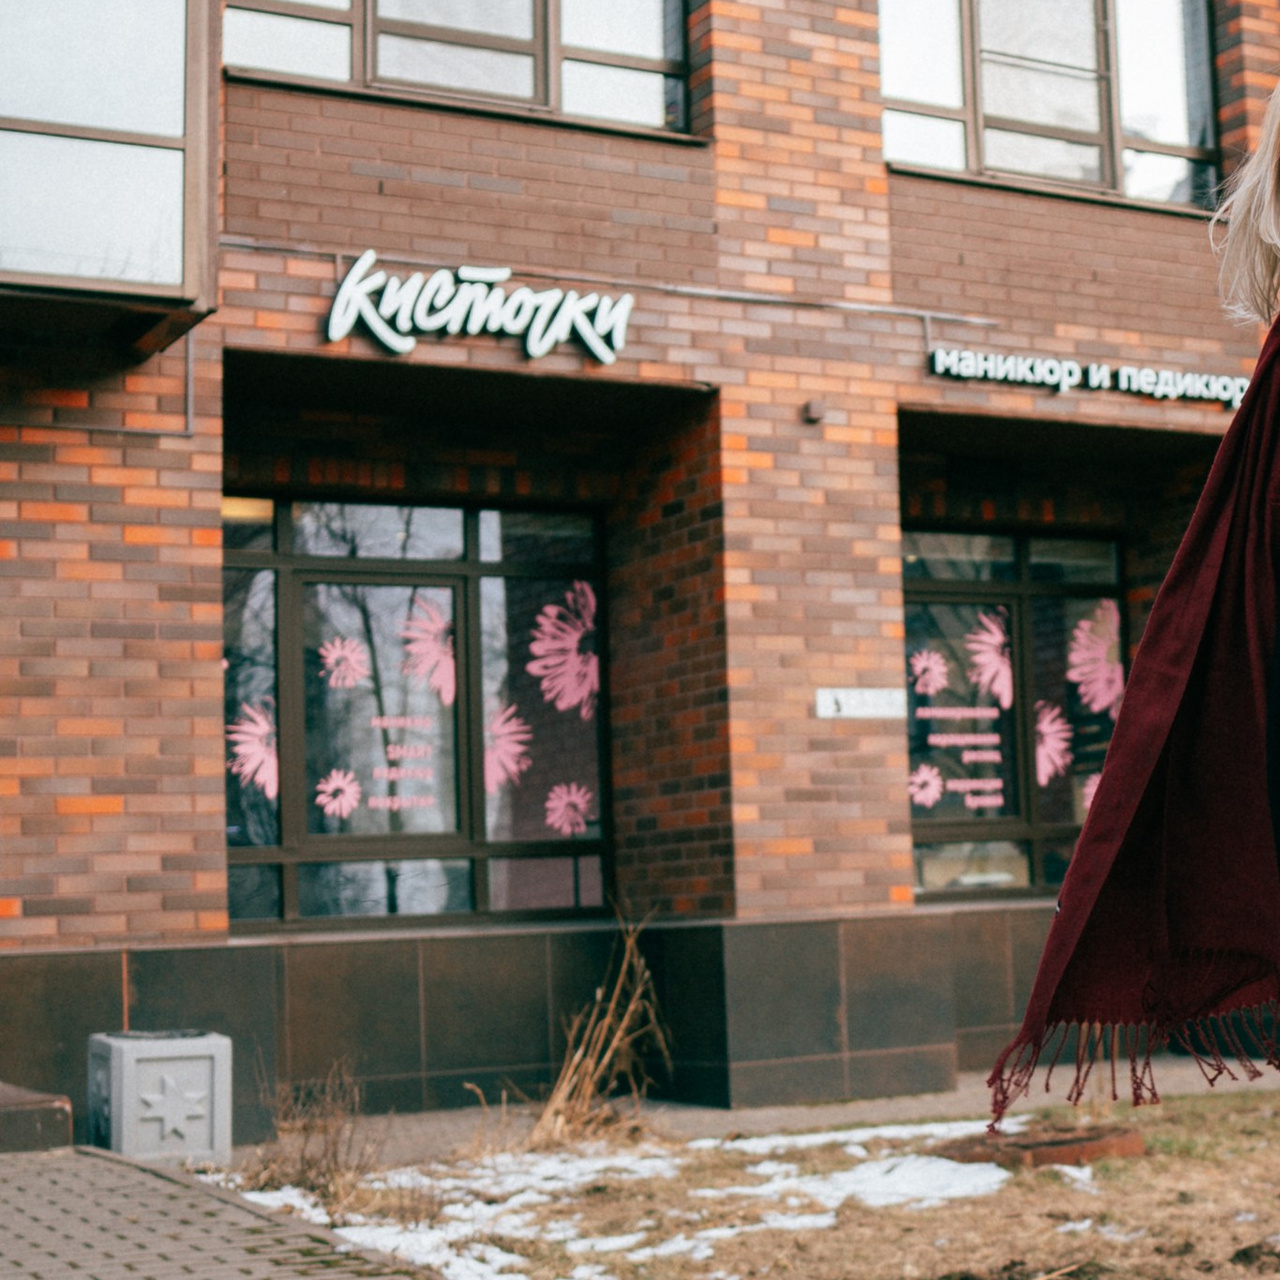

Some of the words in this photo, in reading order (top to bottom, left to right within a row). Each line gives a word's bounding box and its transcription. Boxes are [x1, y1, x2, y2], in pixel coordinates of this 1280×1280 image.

[328, 249, 634, 365] Кисточки
[934, 348, 1081, 394] маникюр
[1087, 363, 1112, 389] и
[1117, 365, 1251, 410] педикюр
